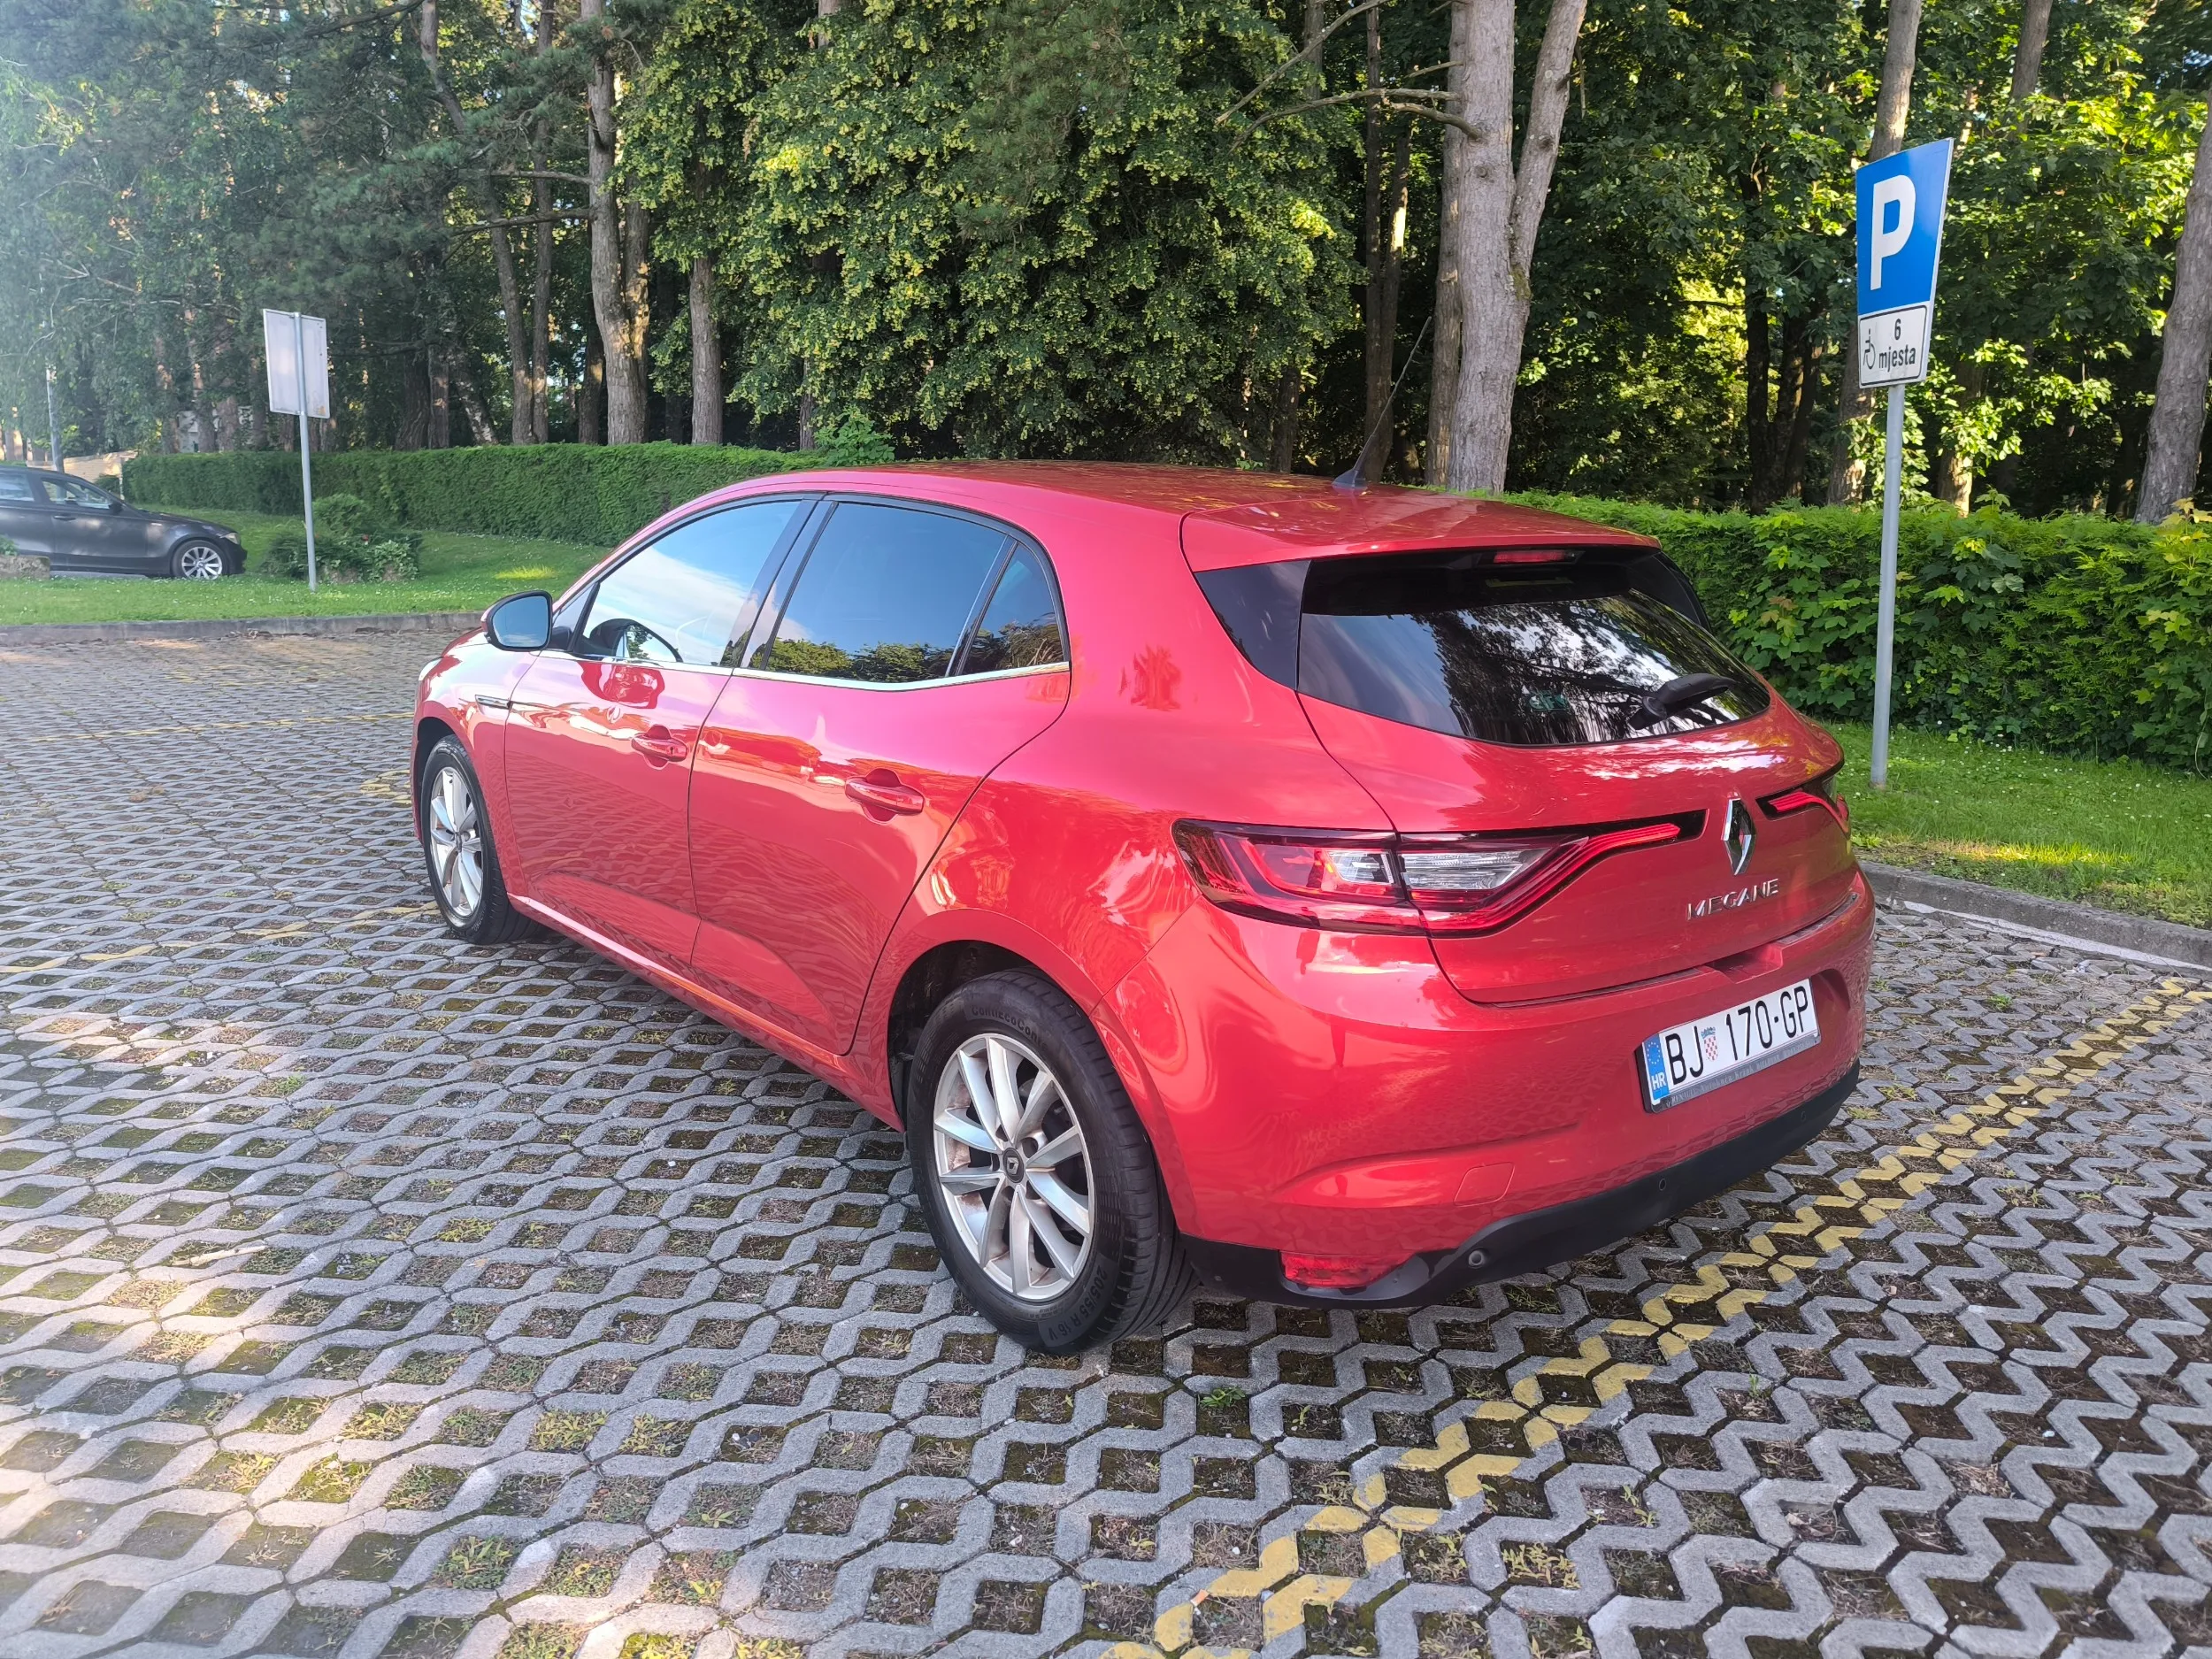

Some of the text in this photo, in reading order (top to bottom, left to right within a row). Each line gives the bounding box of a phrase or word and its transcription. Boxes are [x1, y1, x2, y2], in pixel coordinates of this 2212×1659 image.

[1870, 174, 1916, 290] P
[1893, 318, 1901, 341] 6
[1878, 347, 1916, 372] mjesta
[1686, 879, 1778, 921] MEGANE
[1665, 1025, 1704, 1086] BJ
[1651, 1071, 1666, 1090] HR
[1048, 1265, 1109, 1340] 205/55 R 16 V
